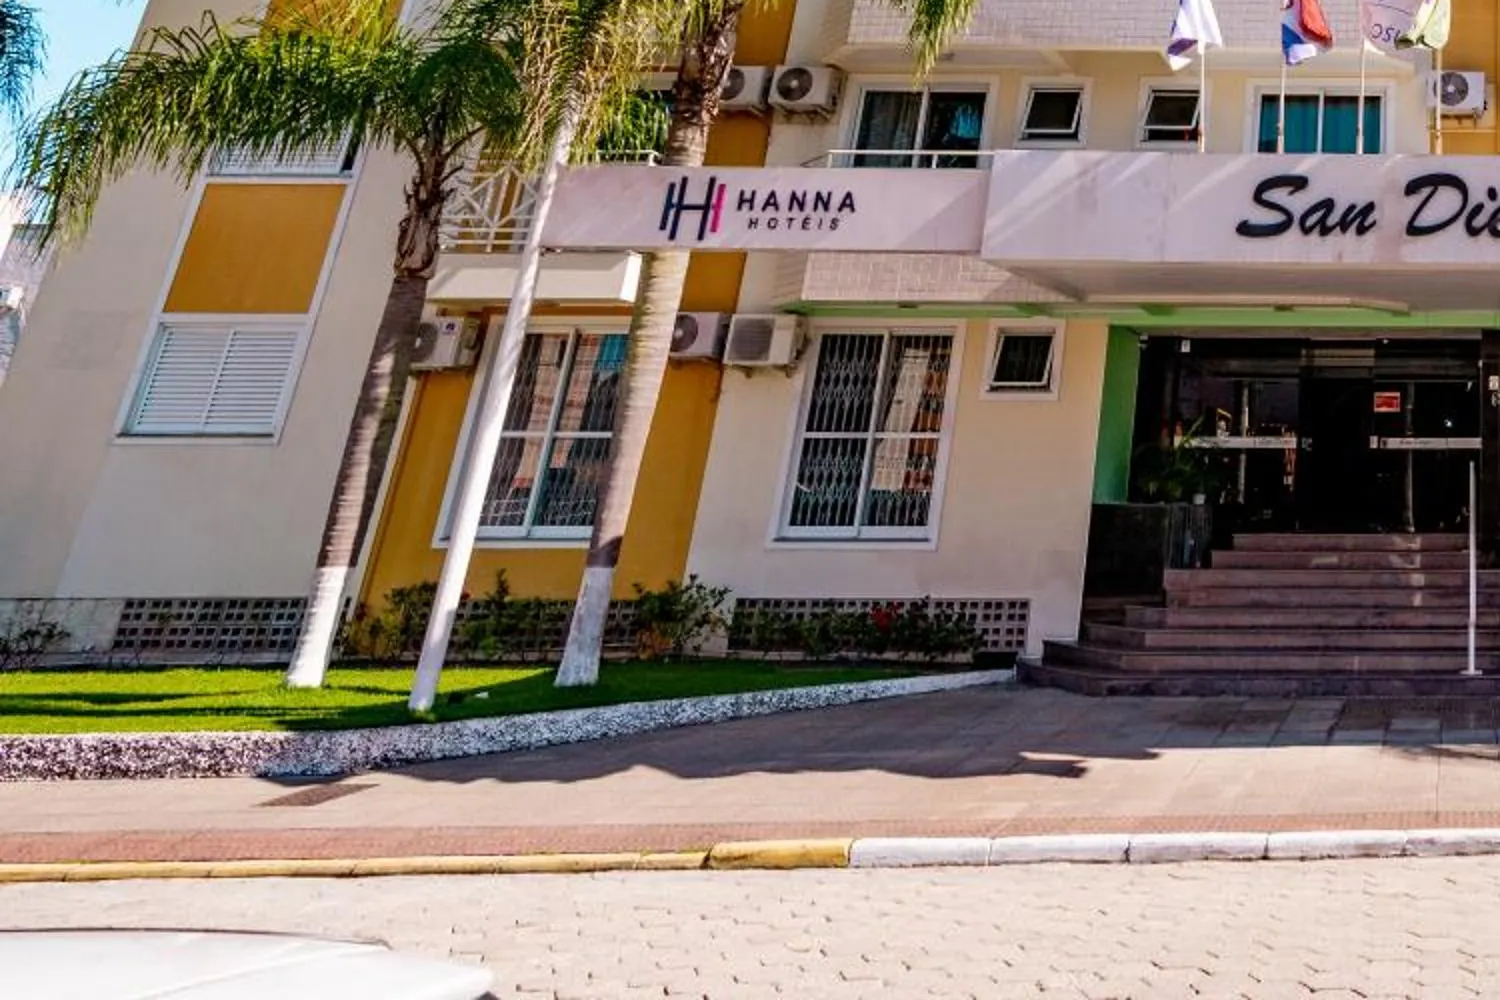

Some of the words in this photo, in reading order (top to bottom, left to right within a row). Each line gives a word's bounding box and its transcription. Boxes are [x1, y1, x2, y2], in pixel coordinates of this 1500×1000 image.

[736, 188, 857, 214] HANNA
[1235, 173, 1378, 239] San
[747, 213, 842, 232] HOTÉIS
